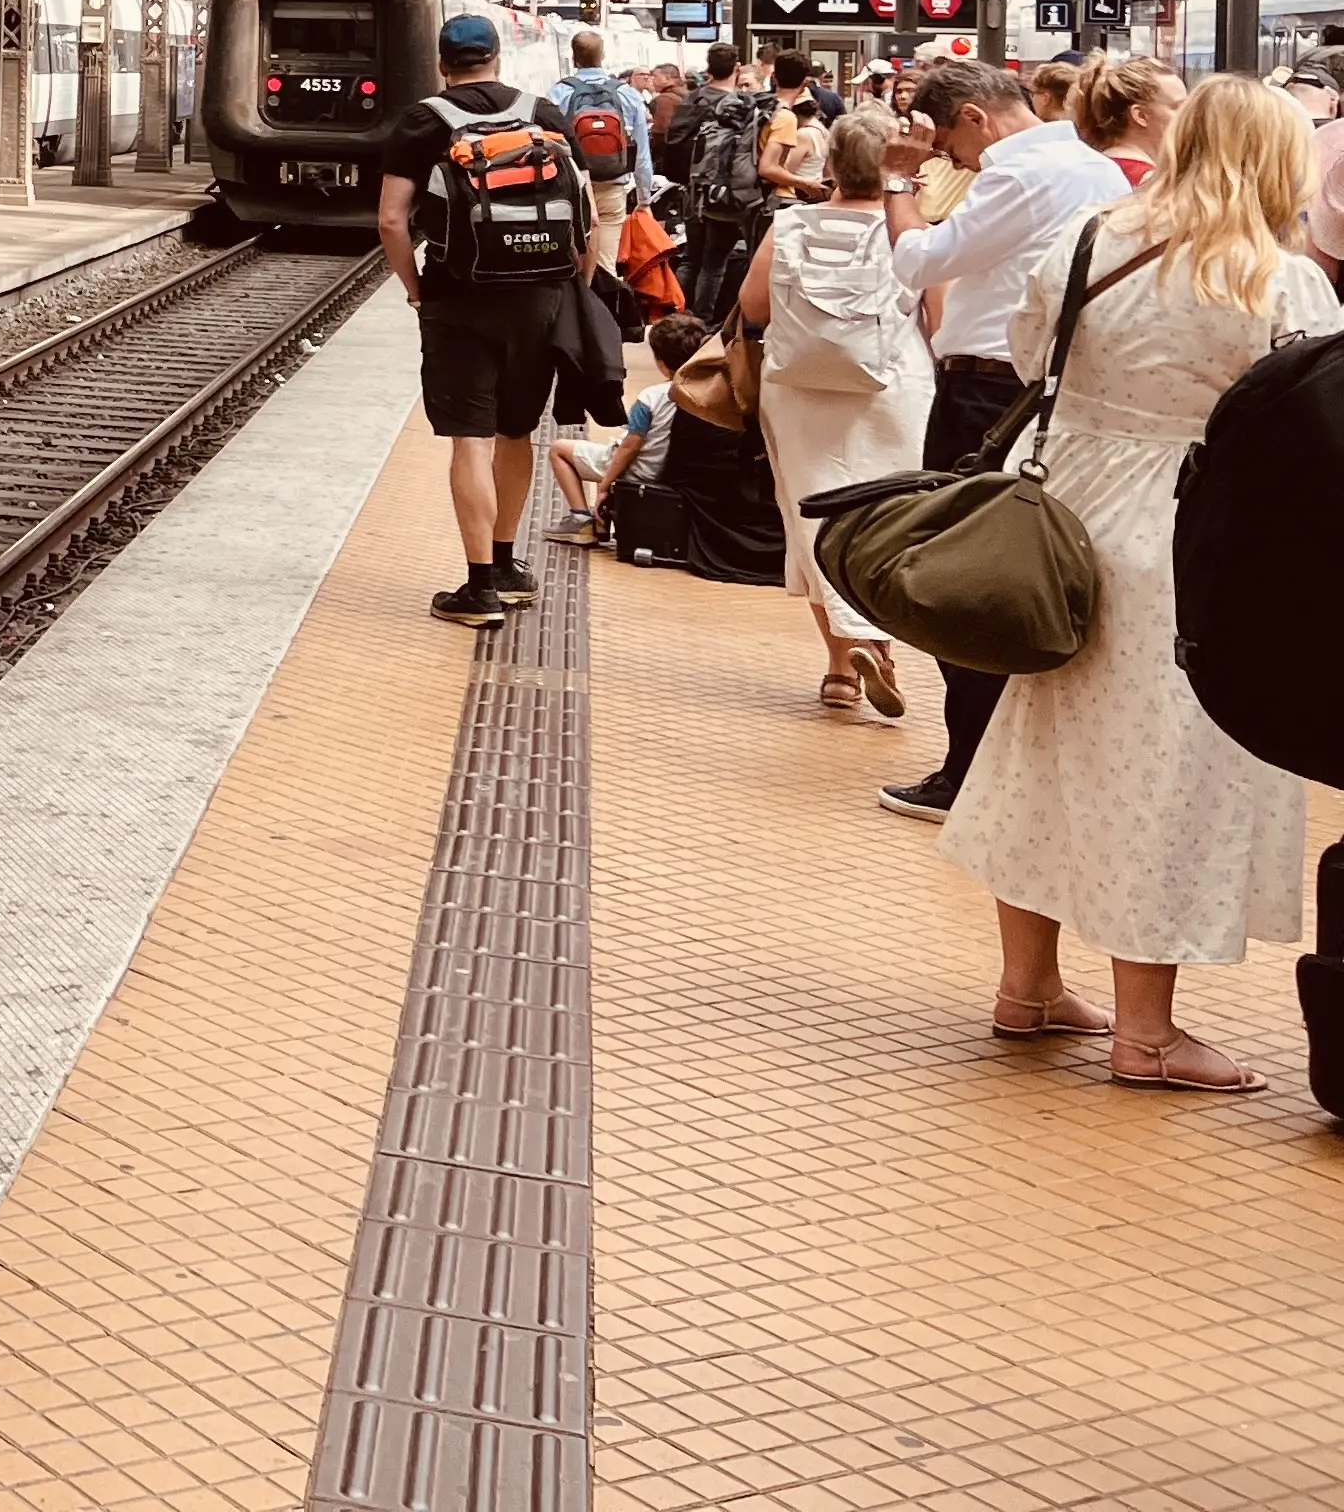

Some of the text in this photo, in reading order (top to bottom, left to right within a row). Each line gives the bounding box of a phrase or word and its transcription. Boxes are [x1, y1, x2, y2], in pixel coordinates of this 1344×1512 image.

[300, 78, 342, 92] 4553
[503, 232, 550, 246] green
[513, 241, 559, 254] cargo
